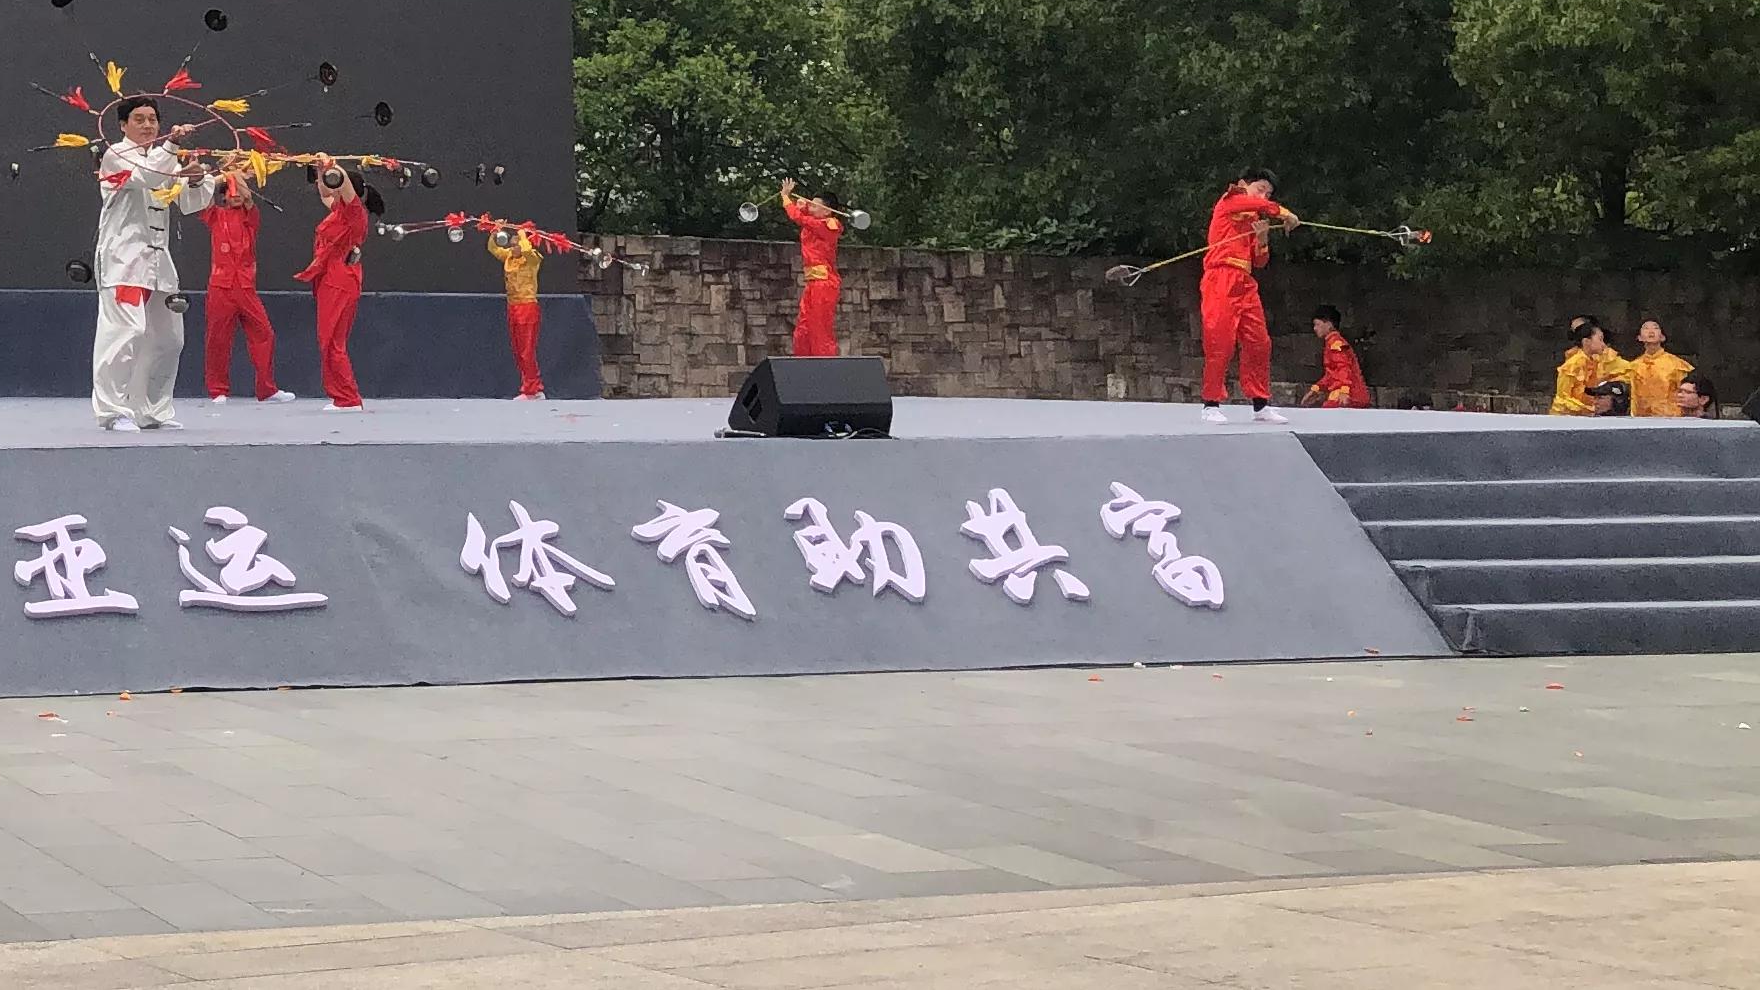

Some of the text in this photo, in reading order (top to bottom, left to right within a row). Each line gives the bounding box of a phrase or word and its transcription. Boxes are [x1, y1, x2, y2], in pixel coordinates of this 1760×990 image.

[459, 481, 1226, 620] 体育助共富
